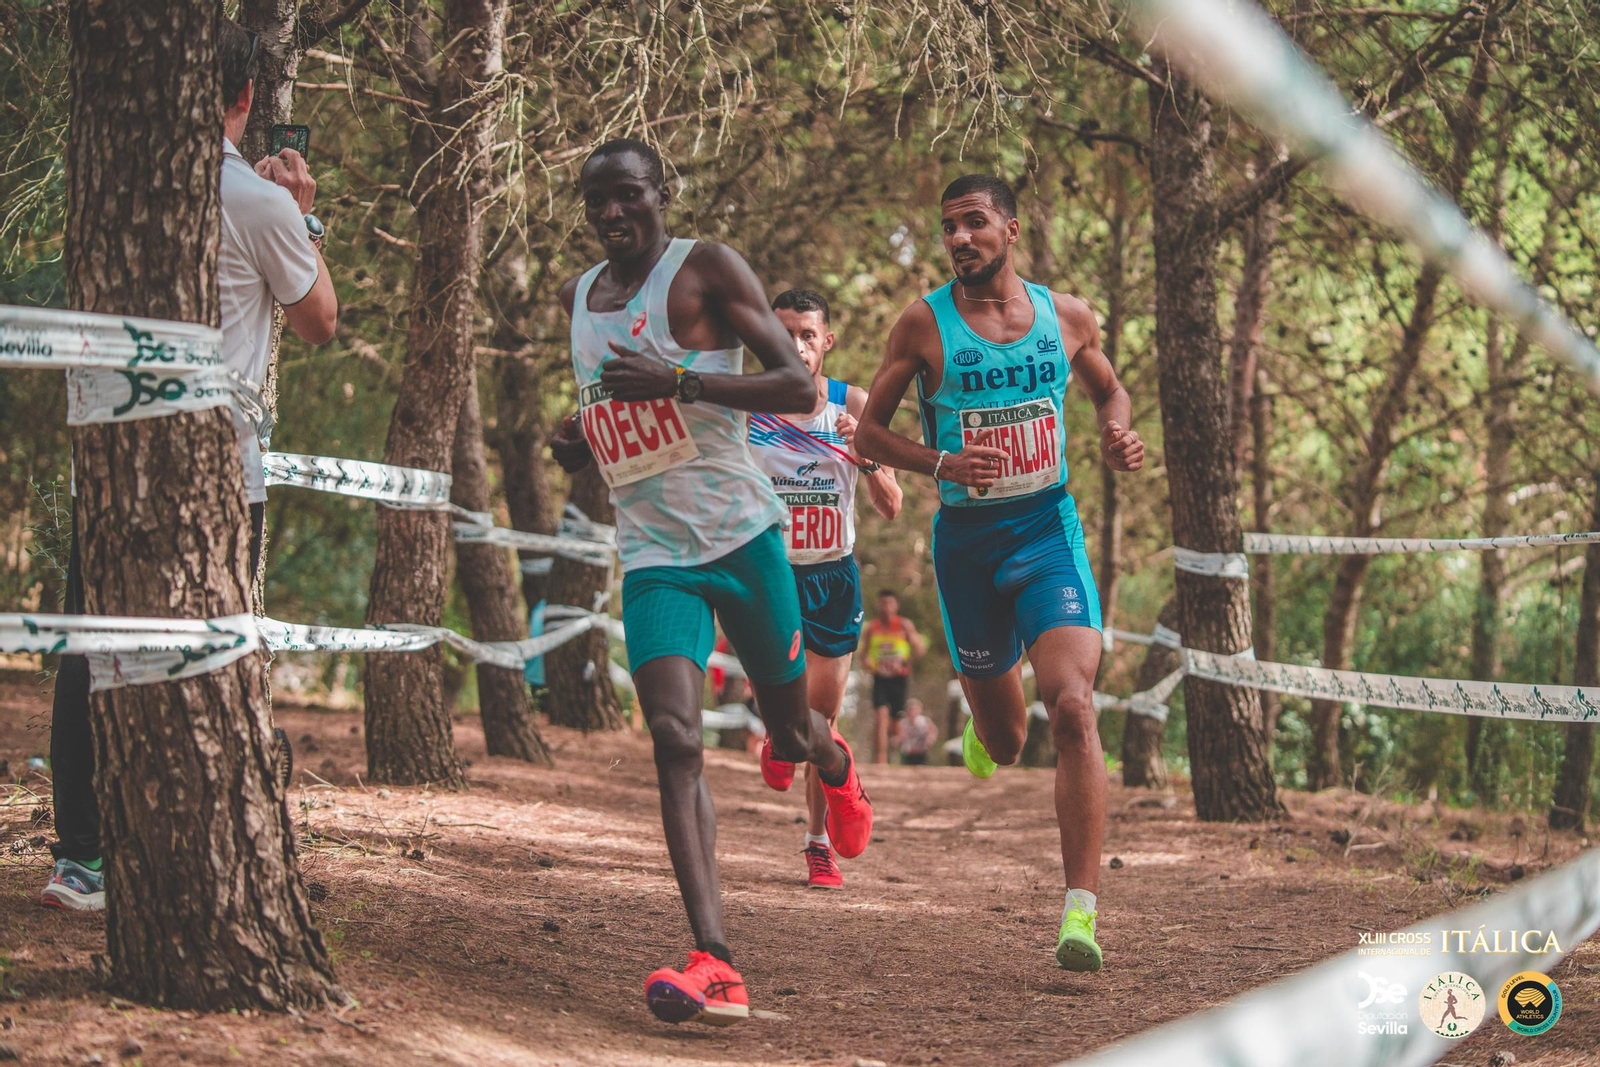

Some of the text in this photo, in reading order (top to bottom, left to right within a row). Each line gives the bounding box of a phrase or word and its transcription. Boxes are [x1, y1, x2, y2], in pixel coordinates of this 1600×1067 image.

[954, 351, 983, 364] TROPS
[959, 355, 1056, 394] nerja
[988, 408, 1033, 424] ITÁLICA
[582, 398, 686, 466] KOECH
[771, 476, 835, 487] Núñez Run
[784, 493, 822, 503] ITÁLICA
[781, 506, 842, 549] ERDI
[958, 646, 991, 659] nerja
